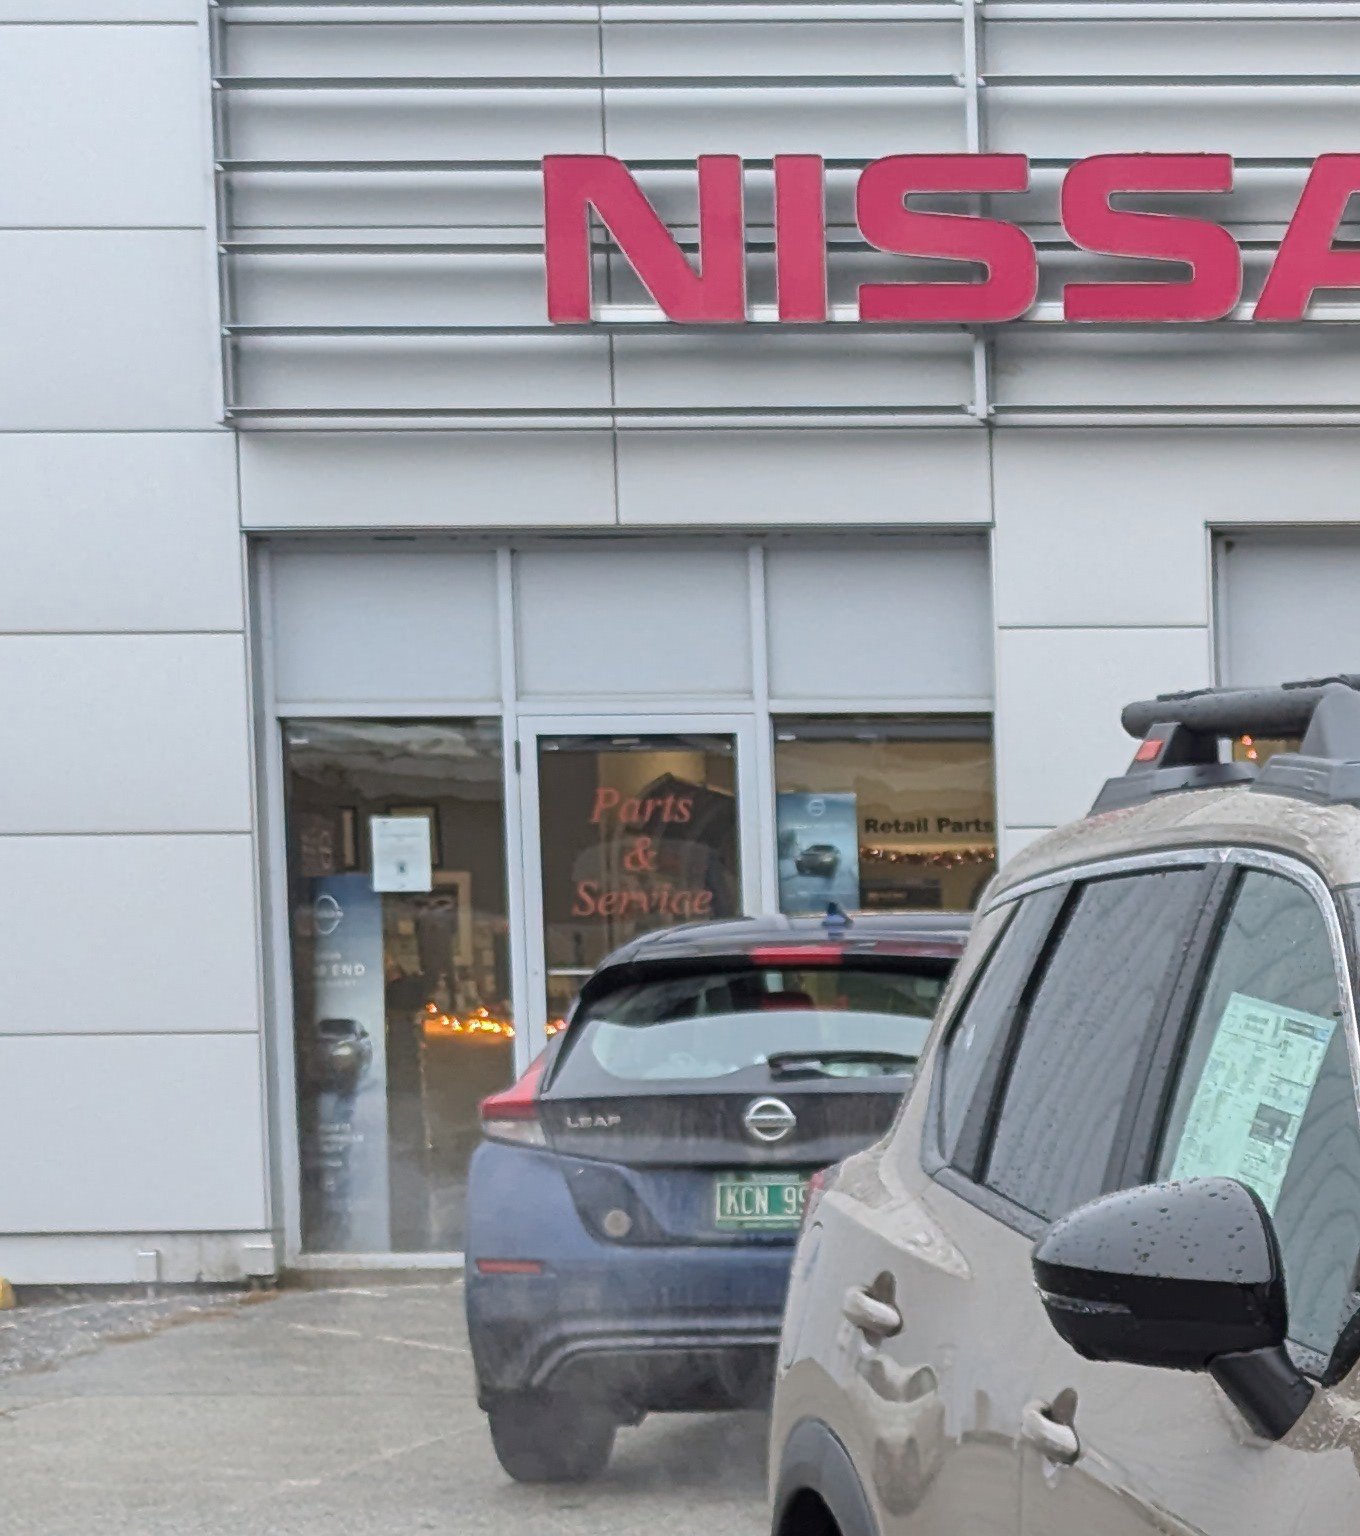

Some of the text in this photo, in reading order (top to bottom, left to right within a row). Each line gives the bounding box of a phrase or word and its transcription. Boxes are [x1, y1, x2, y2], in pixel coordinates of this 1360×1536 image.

[589, 786, 693, 823] Parts
[864, 817, 928, 833] Retail
[624, 837, 657, 871] &
[571, 880, 714, 917] Service
[726, 1186, 769, 1214] KCN
